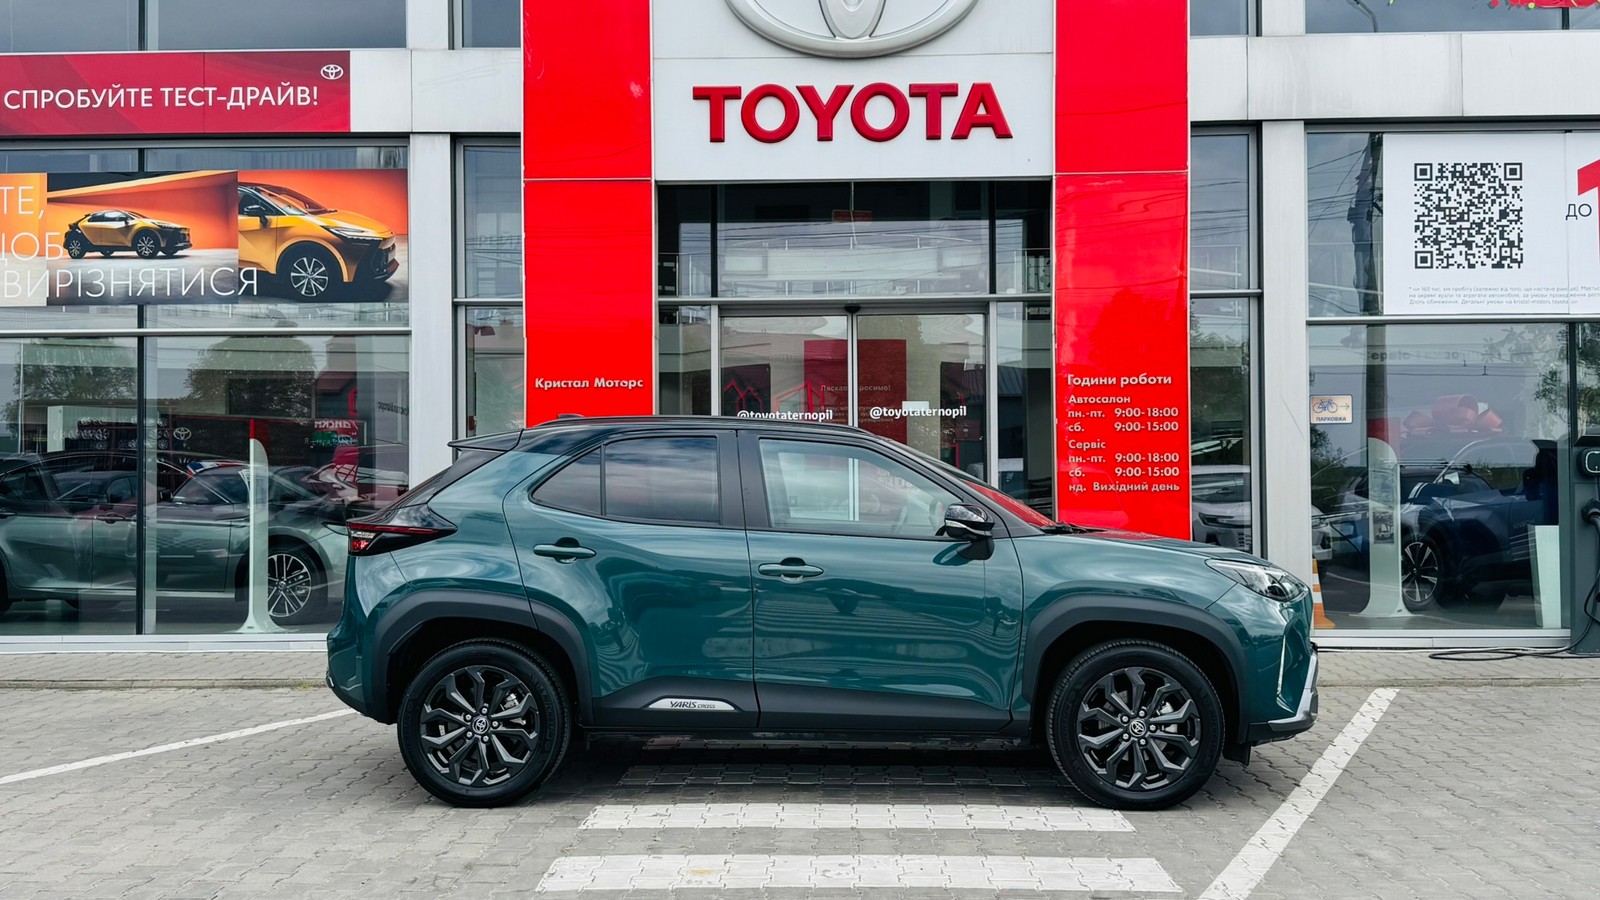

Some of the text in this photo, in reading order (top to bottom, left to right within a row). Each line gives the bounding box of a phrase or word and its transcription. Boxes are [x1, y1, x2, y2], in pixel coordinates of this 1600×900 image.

[4, 81, 319, 111] СПРОБУЙТЕ ТЕСТ-ДРАЙВ!
[692, 82, 1013, 143] TOYOTA
[4, 267, 259, 299] ВИРІЗНЯТИСЯ
[535, 377, 644, 391] Кристал Моторс
[1067, 373, 1172, 388] Години роботи
[857, 385, 891, 393] росимо!
[1068, 394, 1131, 404] Автосалон
[869, 406, 967, 420] @toyotaternopil
[1067, 407, 1179, 418] пн.-пт. 9:00-18:00
[1068, 422, 1179, 432] сб. 9:00-15:00
[1068, 439, 1106, 451] Сервіс
[1068, 452, 1180, 463] пн.-пт. 9:00-18:00
[1069, 466, 1180, 477] сб. 9:00-15:00
[1069, 481, 1180, 492] нд. Вихідний день
[670, 701, 697, 709] YARIS
